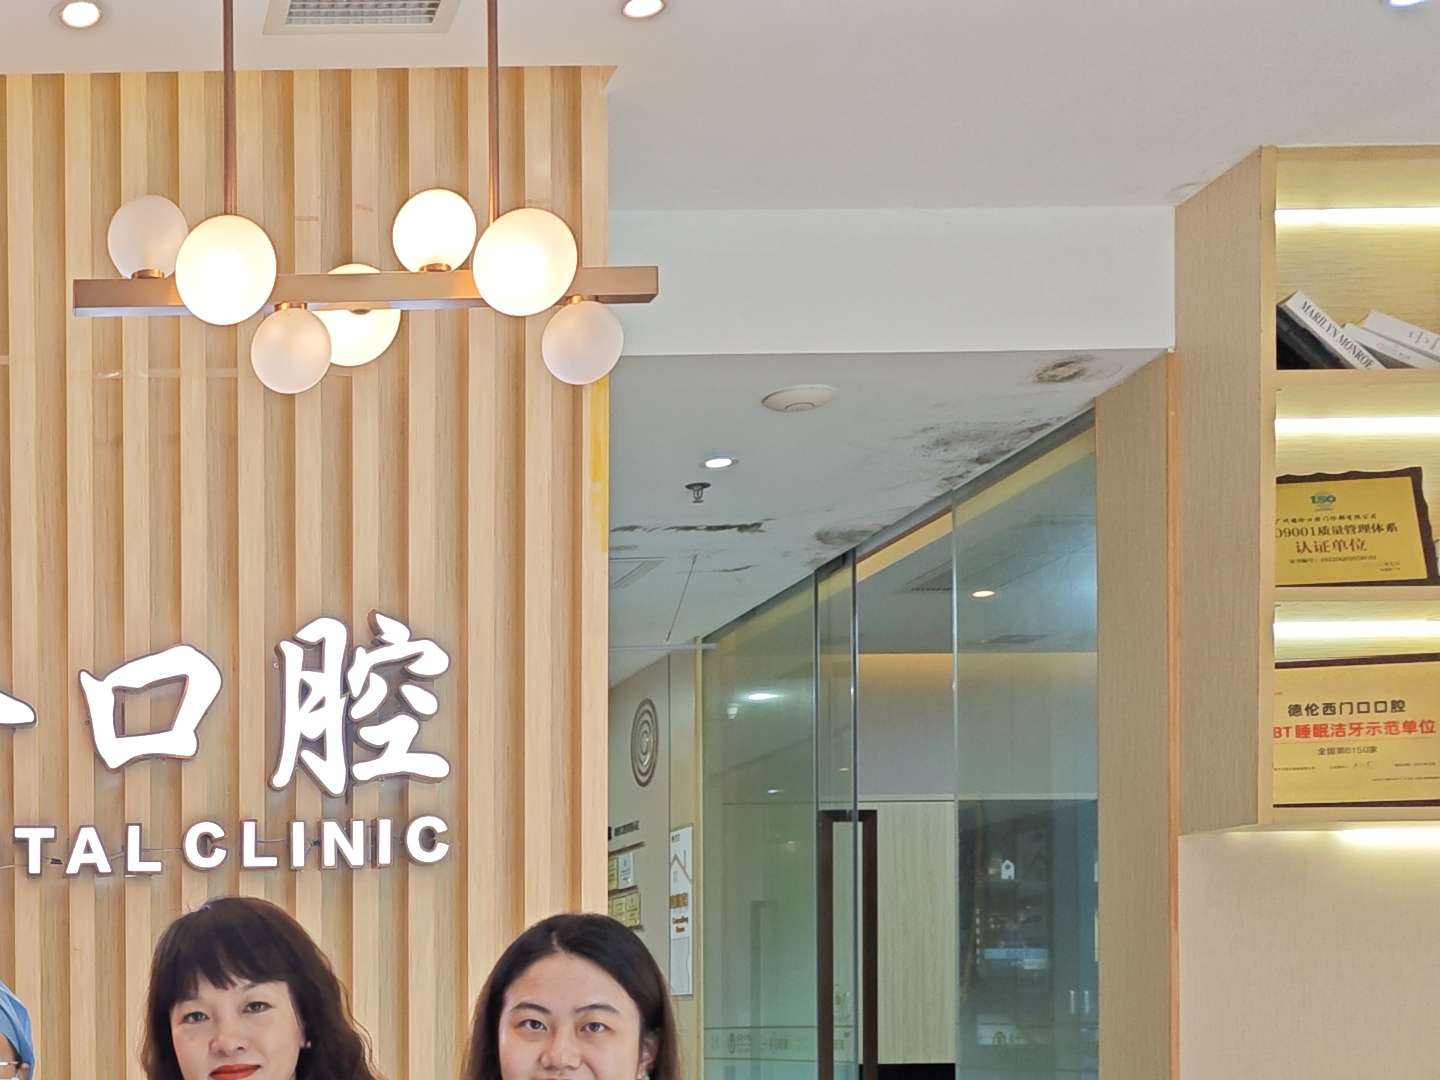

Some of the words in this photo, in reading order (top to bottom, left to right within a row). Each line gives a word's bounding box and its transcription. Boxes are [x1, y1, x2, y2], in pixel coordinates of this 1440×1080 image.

[1299, 300, 1338, 339] MARILYN
[1335, 332, 1376, 370] MONROE
[1310, 495, 1337, 505] ISO
[1295, 538, 1367, 554] 认证单位
[1288, 700, 1406, 717] 德伦西门口口腔
[183, 815, 452, 871] CLINIC
